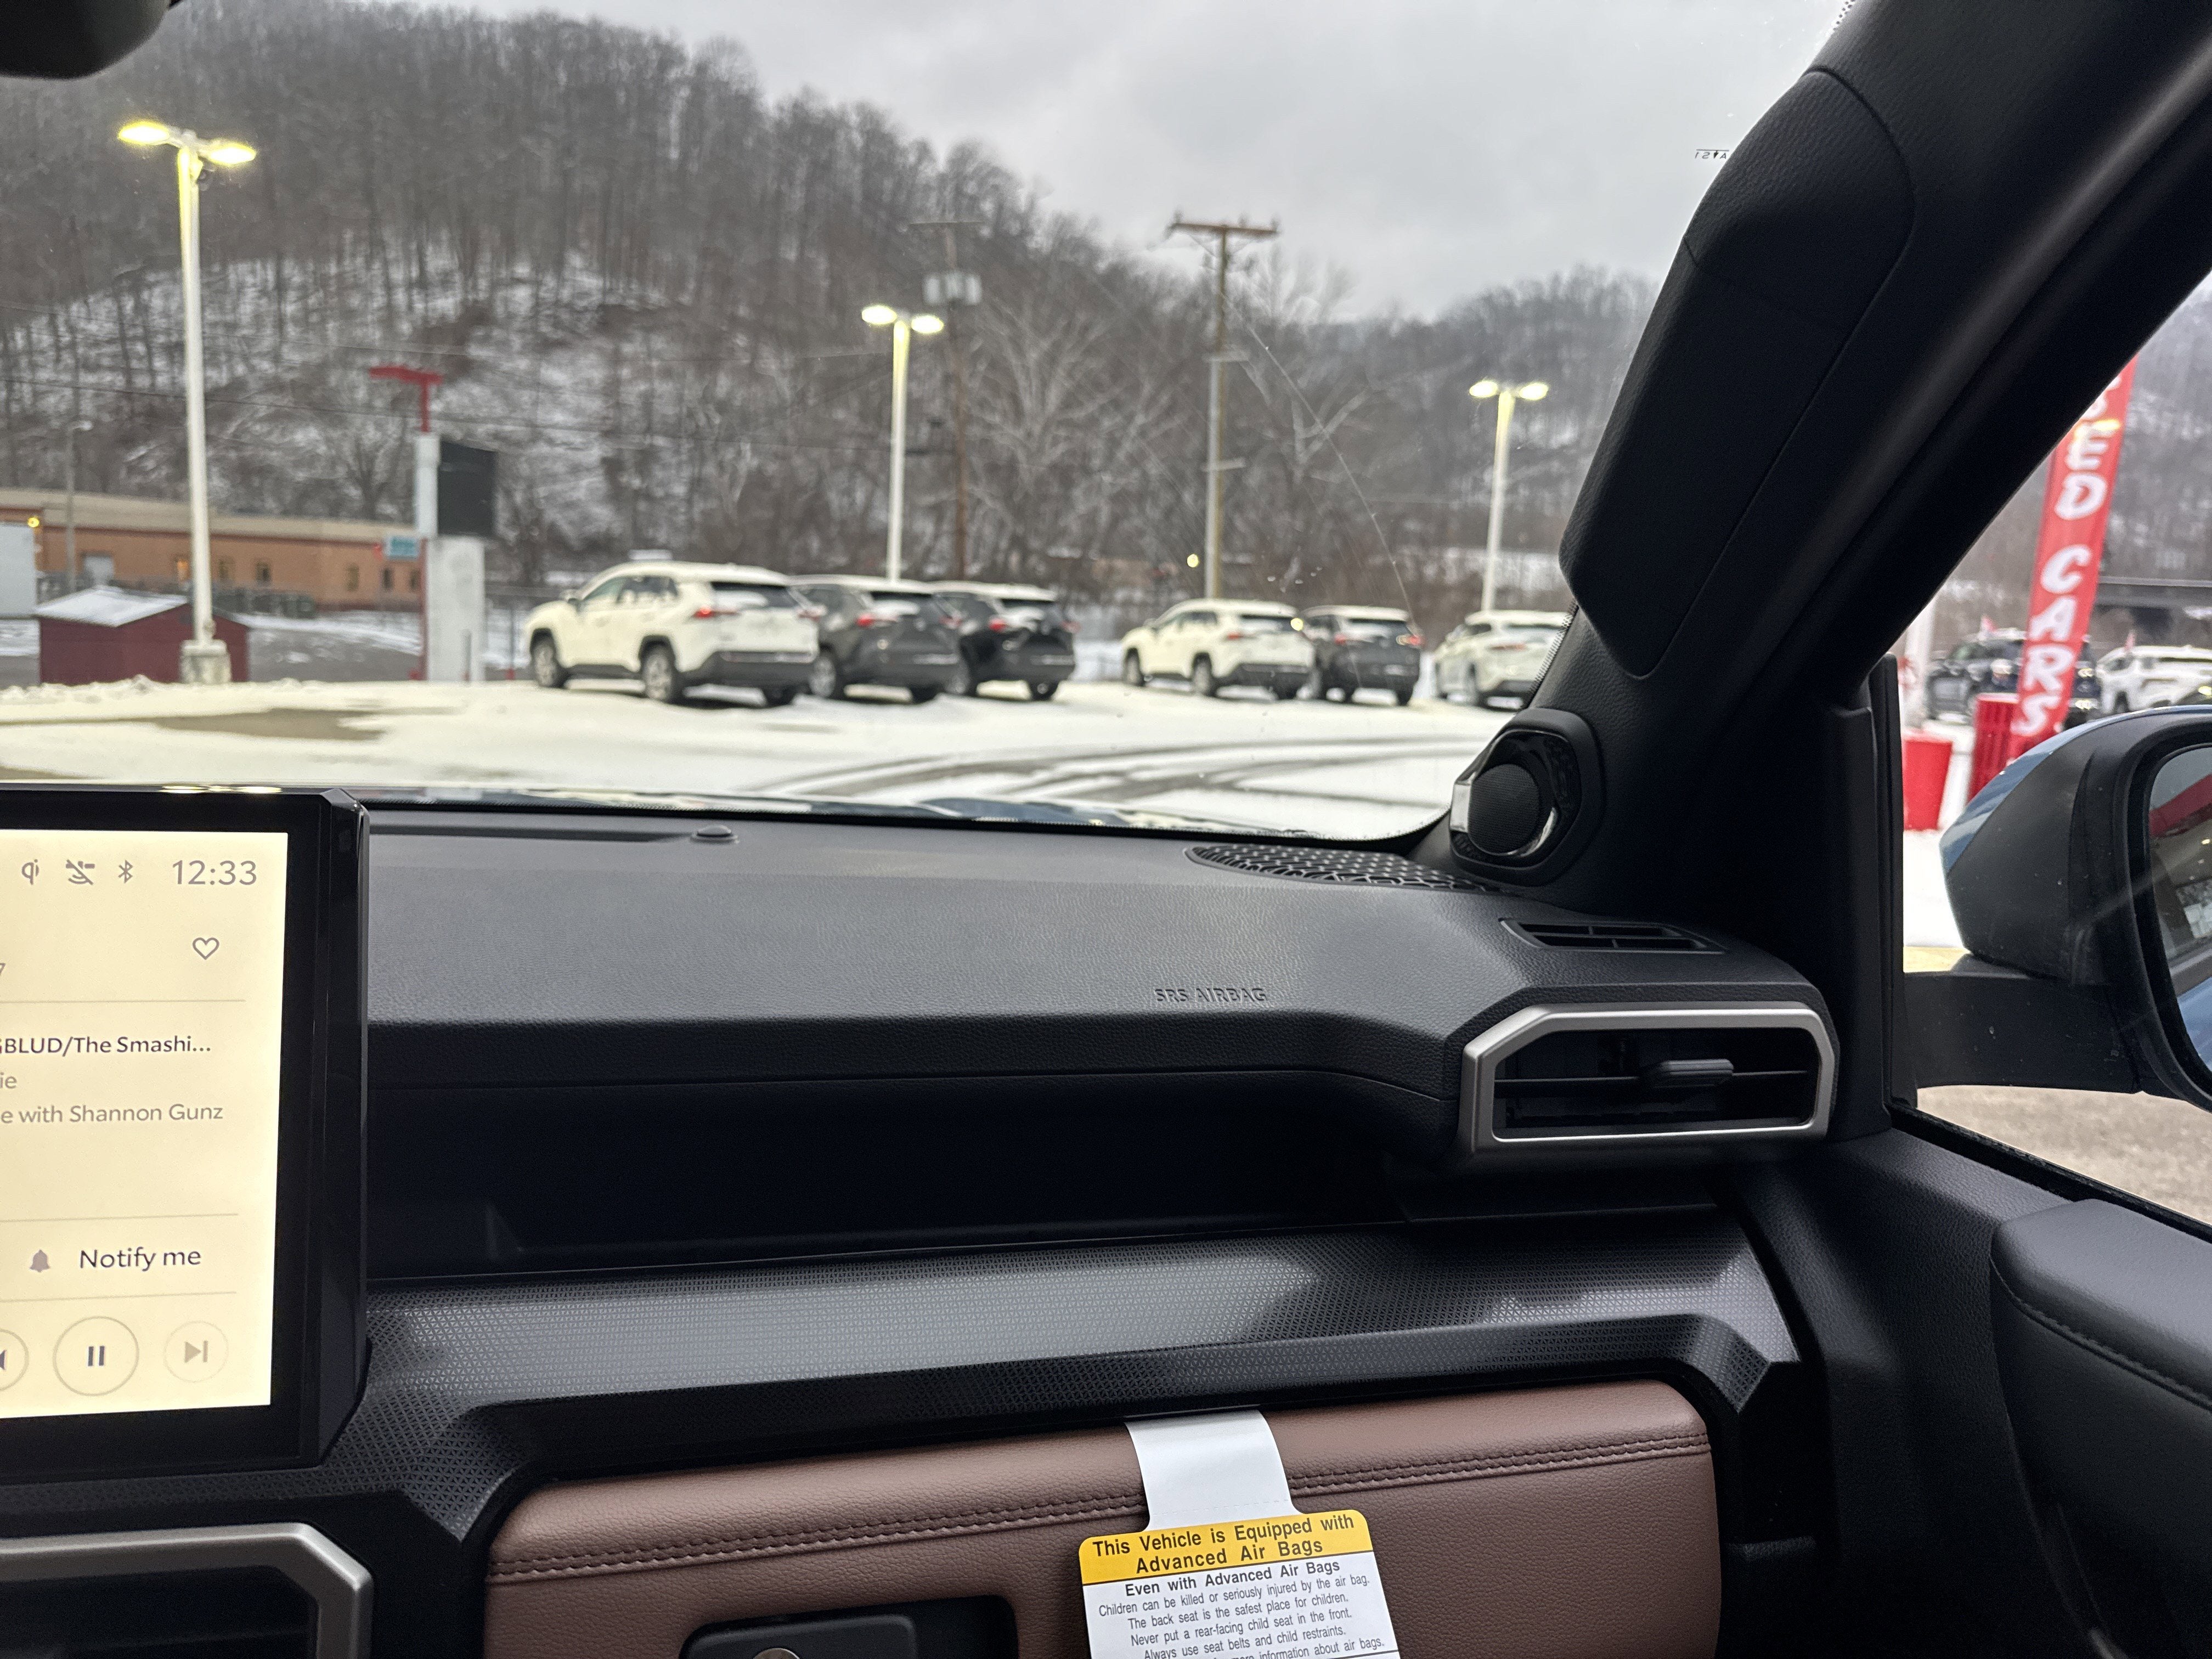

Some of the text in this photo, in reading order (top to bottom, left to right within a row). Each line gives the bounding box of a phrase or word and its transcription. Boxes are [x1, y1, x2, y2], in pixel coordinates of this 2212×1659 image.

[2010, 544, 2091, 736] CARS
[172, 860, 257, 885] 12:33
[1153, 988, 1267, 1002] SRS AIRBAG
[0, 1036, 112, 1057] BLUD/The
[18, 1105, 63, 1123] with
[70, 1104, 162, 1123] Shannon
[169, 1103, 223, 1121] Gunz
[79, 1246, 201, 1272] Notify me
[1093, 1514, 1355, 1556] This Vehicle is Equipped with
[1136, 1539, 1323, 1573] Advanced Air Bags
[1125, 1561, 1340, 1596] Even with Advanced Air Bags
[1099, 1574, 1370, 1617] Children can be killed or seriously injured by the air bag.
[1128, 1593, 1348, 1629] The back seat is the safest place for children.
[1131, 1607, 1352, 1646] Never put a rear-facing child seat in the front.
[1144, 1626, 1346, 1659] Always use seat belts and child restraints.
[1259, 1637, 1385, 1659] information about air bags.
